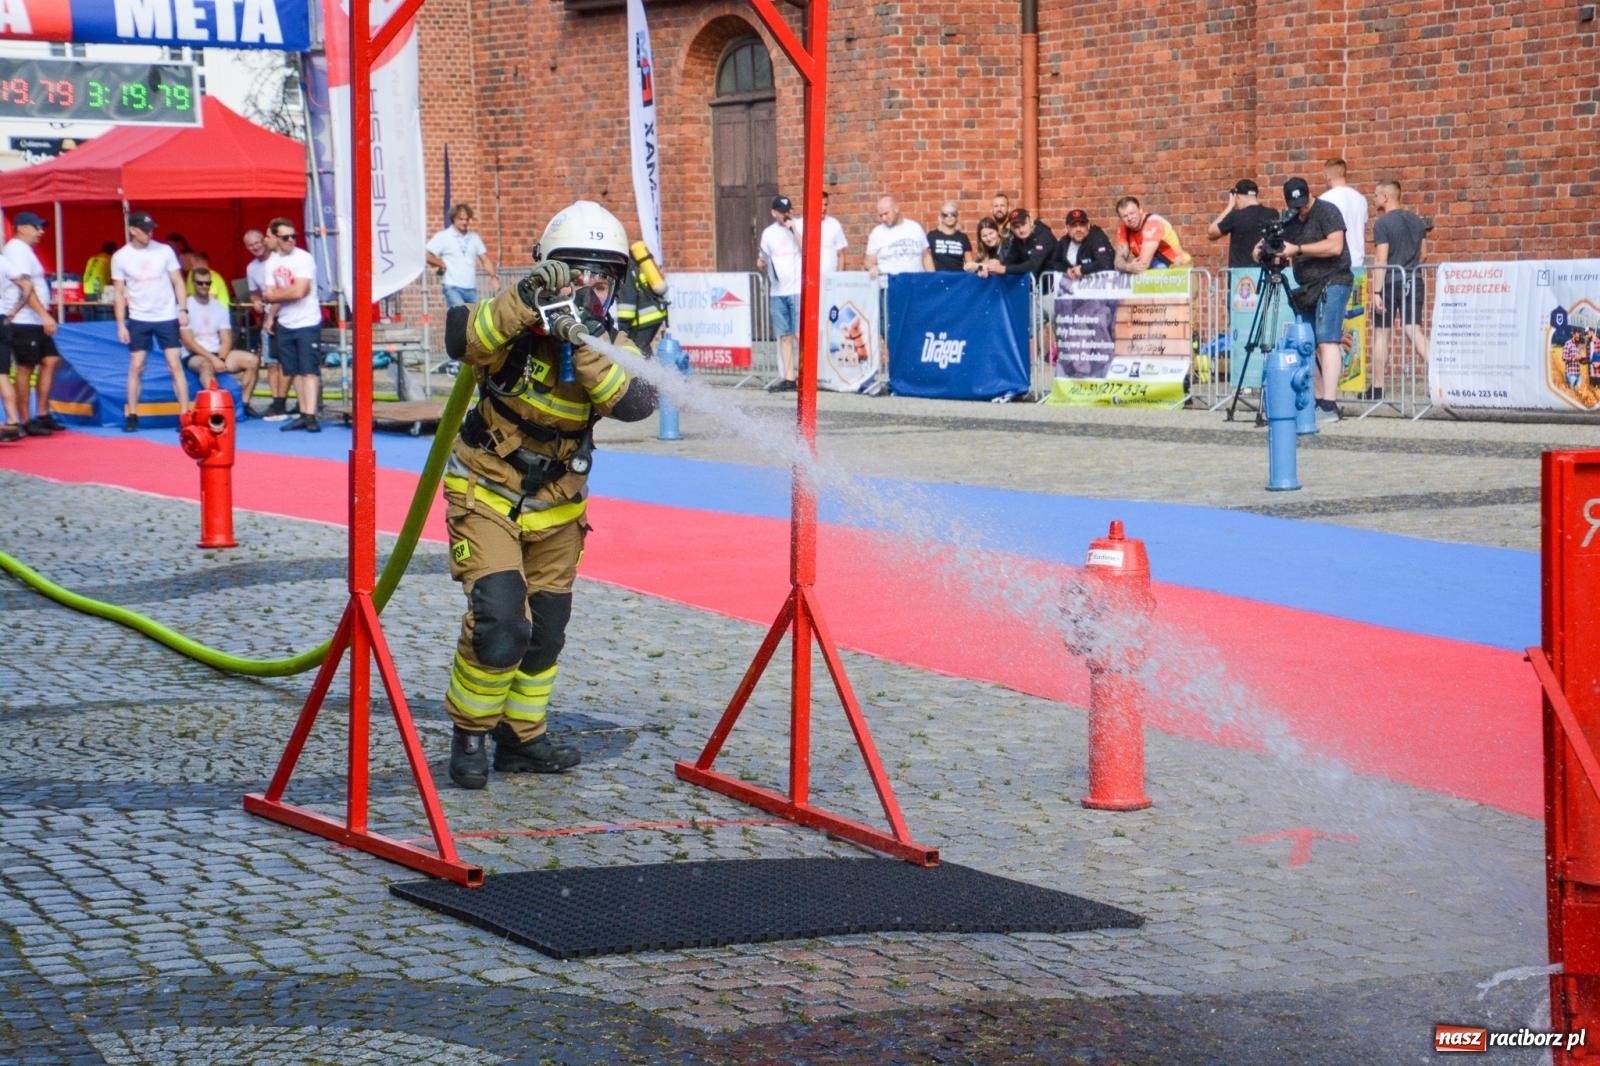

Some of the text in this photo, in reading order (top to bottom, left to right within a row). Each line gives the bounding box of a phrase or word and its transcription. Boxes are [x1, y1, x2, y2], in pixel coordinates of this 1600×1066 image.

[113, 0, 285, 44] META
[589, 231, 605, 241] 19
[1444, 268, 1504, 280] SPECJALIŚCI
[921, 331, 967, 369] Dräger
[1462, 390, 1476, 398] 604
[1478, 390, 1491, 398] 223
